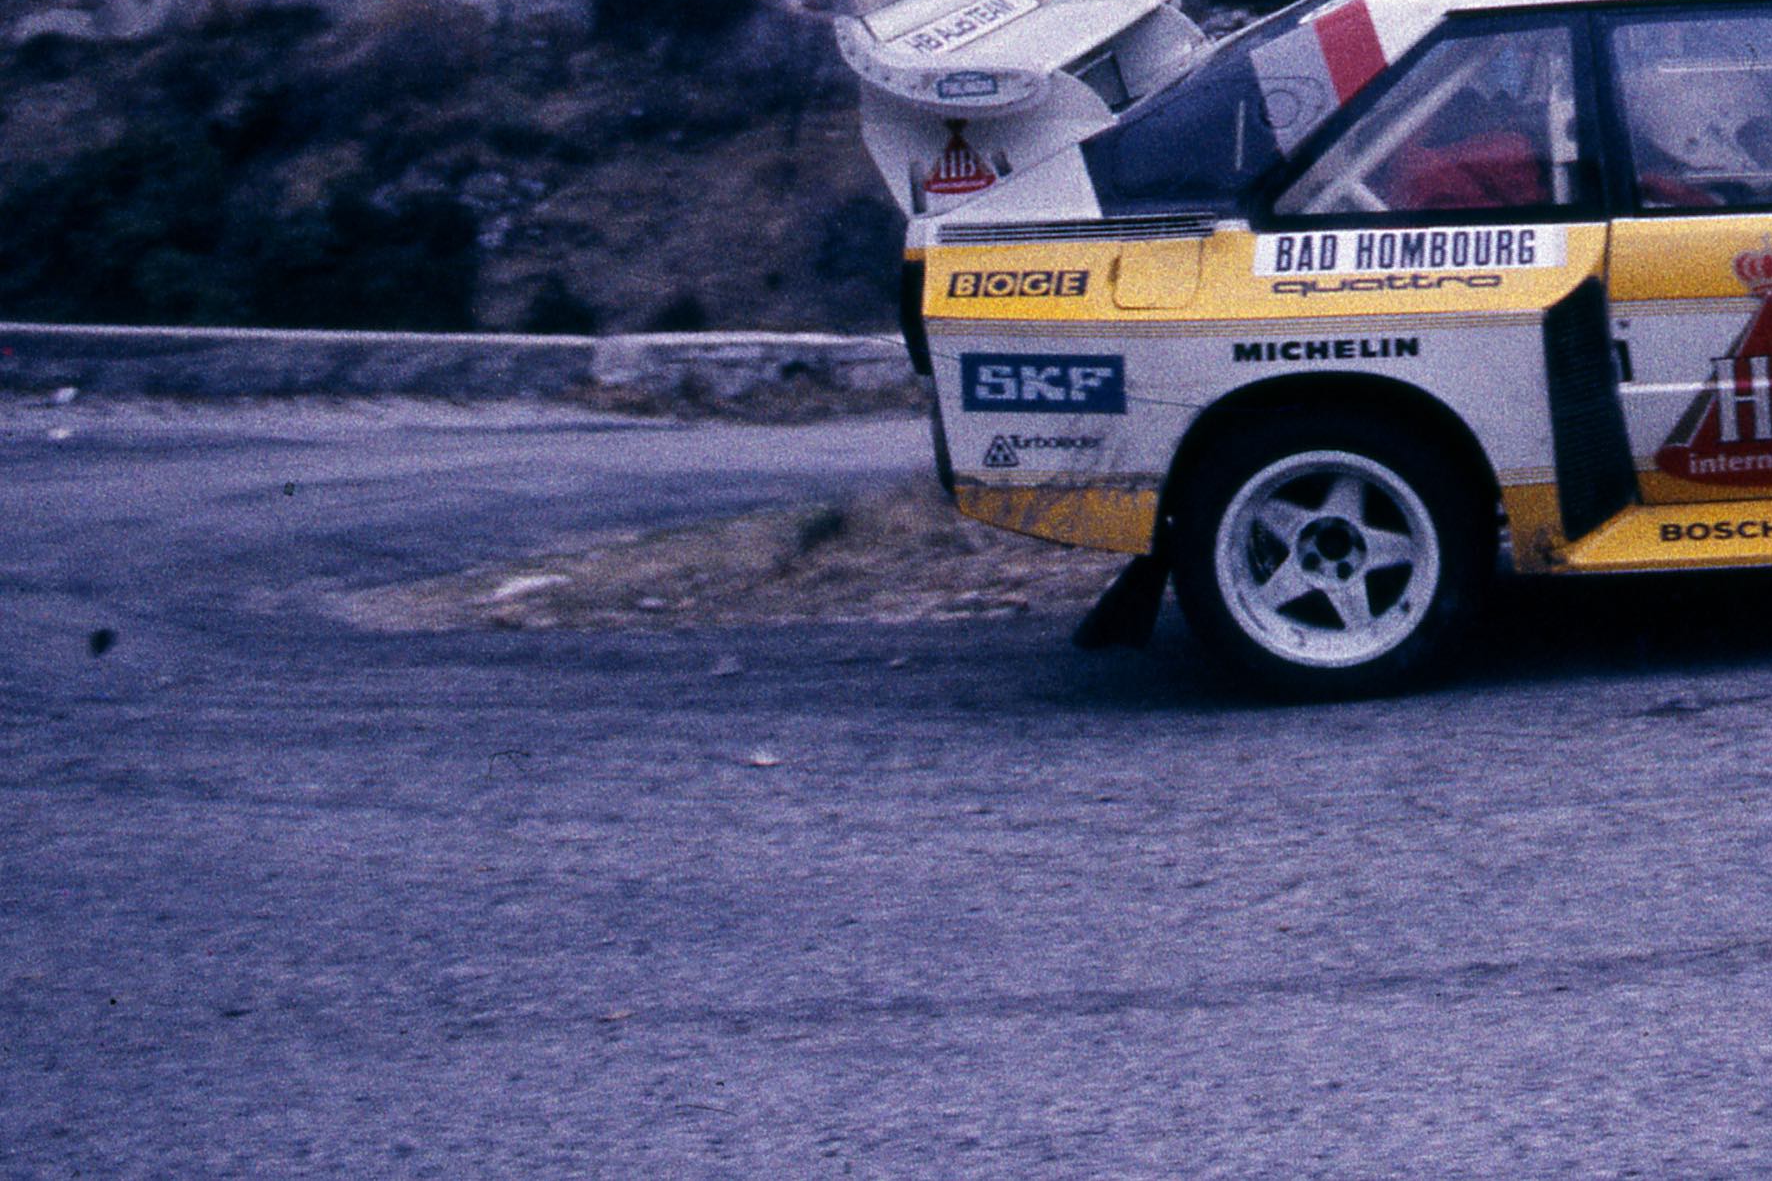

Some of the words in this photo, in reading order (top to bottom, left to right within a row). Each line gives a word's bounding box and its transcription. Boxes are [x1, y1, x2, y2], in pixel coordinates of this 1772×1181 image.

[939, 149, 977, 179] HB
[1275, 234, 1338, 271] BAD
[1356, 229, 1535, 269] HOMBOURG
[951, 272, 1085, 296] BOGE
[1272, 274, 1502, 297] quattro
[1233, 337, 1419, 361] MICHELIN
[975, 365, 1115, 400] SKF
